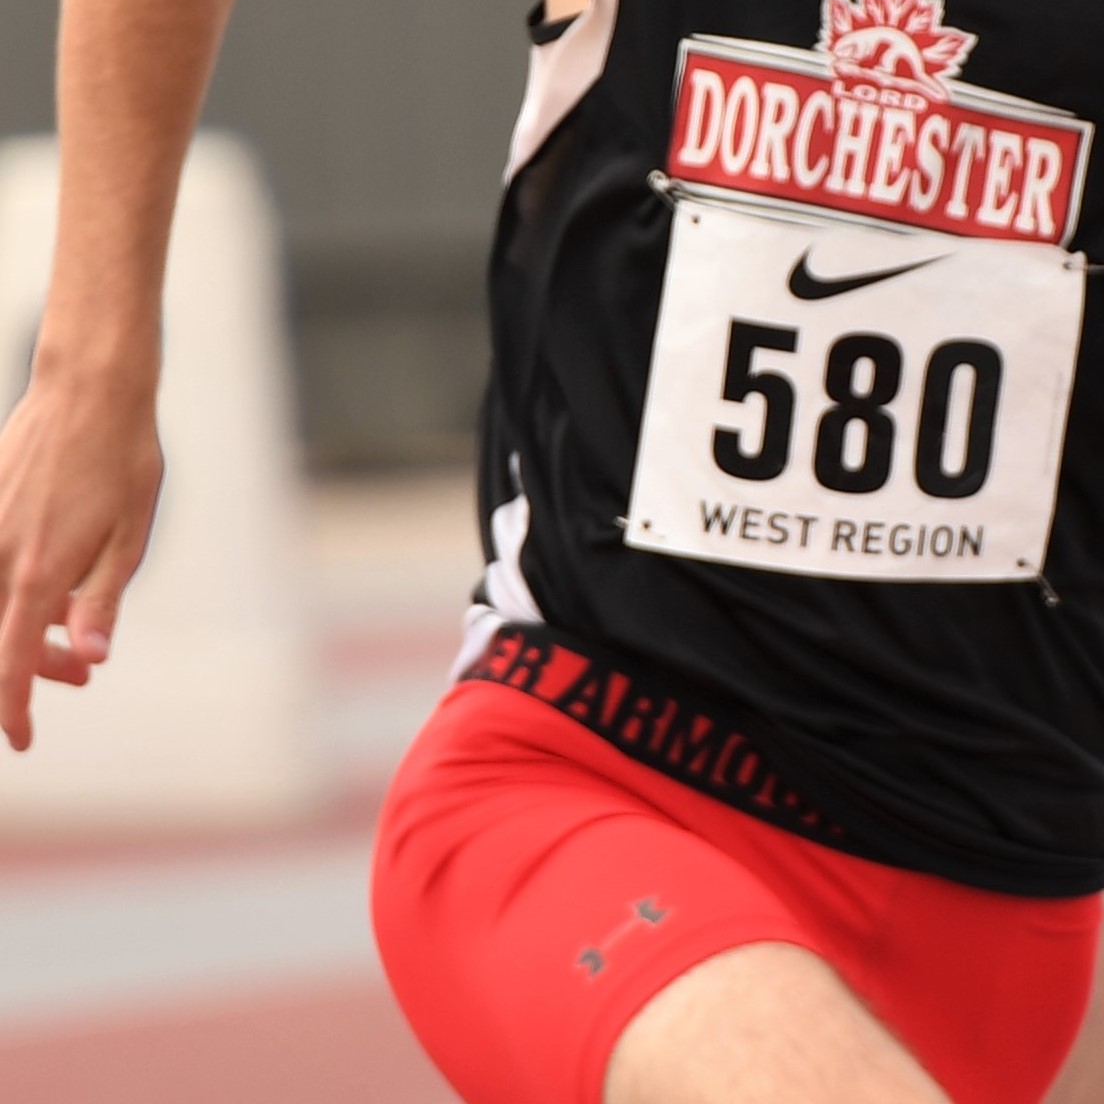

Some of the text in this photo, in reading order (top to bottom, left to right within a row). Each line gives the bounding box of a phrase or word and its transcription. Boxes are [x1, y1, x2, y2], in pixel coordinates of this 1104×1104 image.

[832, 78, 928, 114] LORD
[679, 69, 1062, 237] DORCHESTER
[712, 316, 1003, 498] 580
[699, 501, 984, 557] WEST REGION
